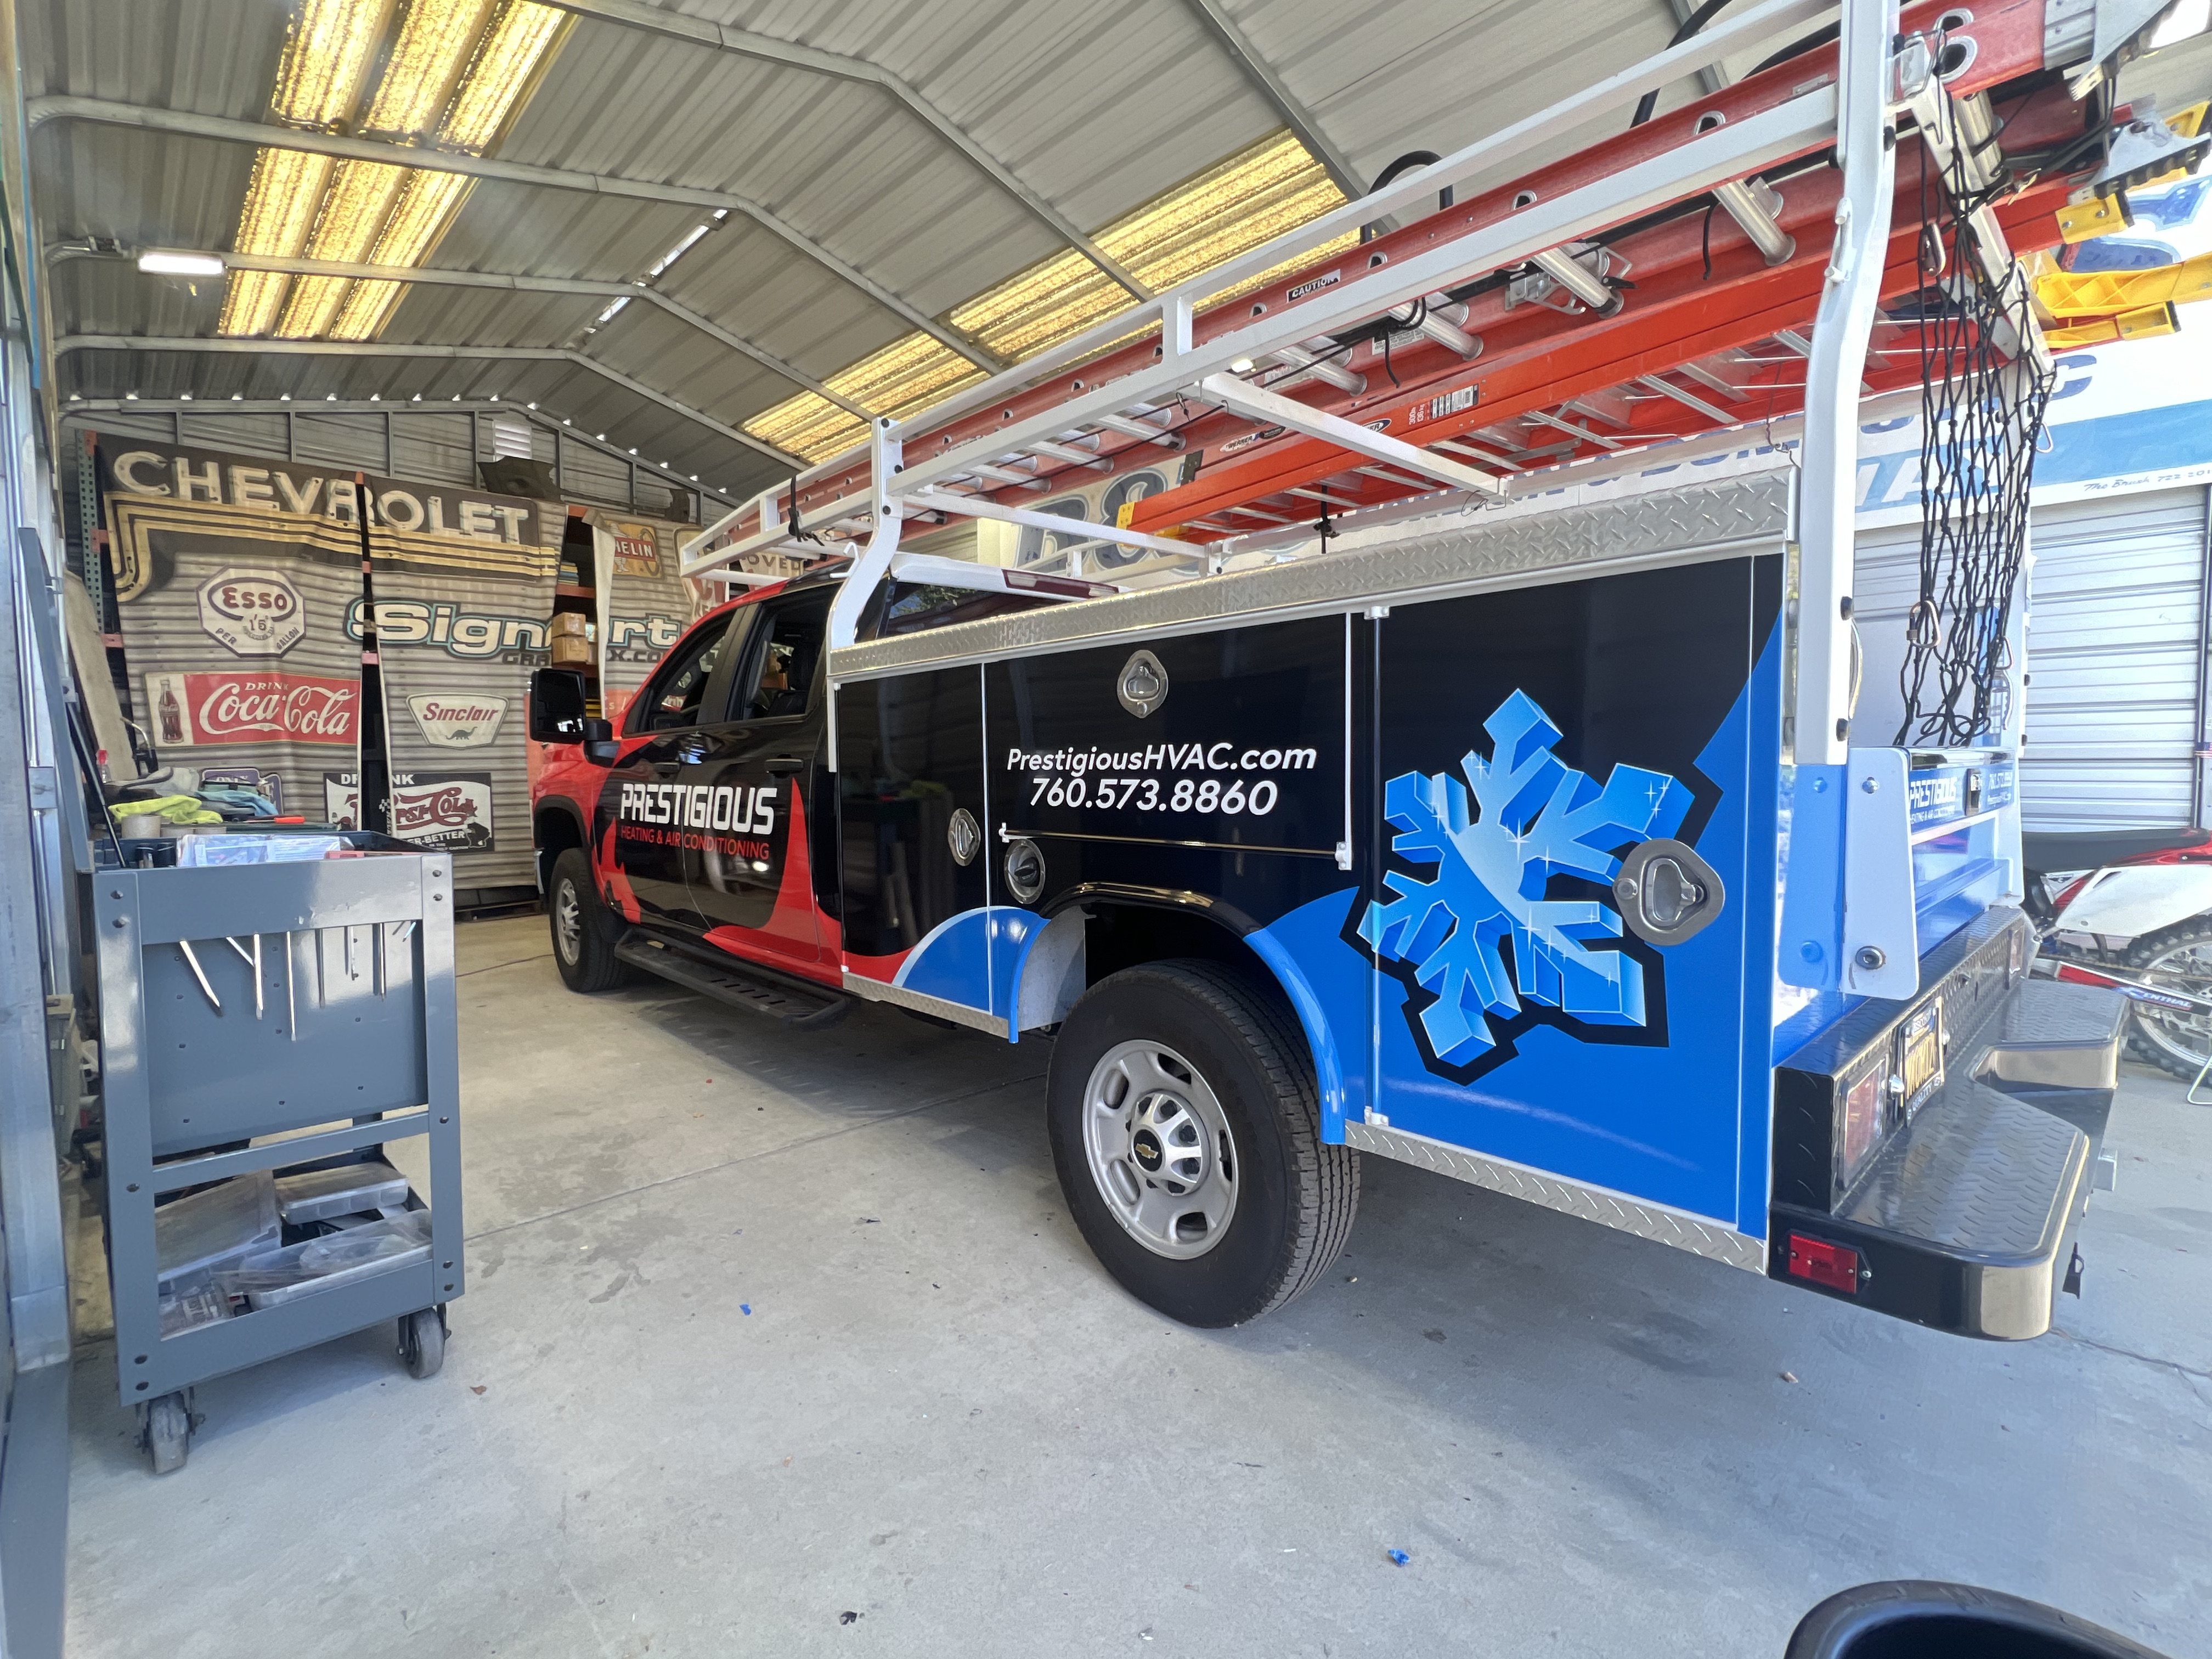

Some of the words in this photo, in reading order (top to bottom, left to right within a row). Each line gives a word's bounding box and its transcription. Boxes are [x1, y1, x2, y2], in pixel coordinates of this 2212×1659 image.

[114, 451, 528, 545] CHEVROLET
[215, 628, 238, 645] PER
[276, 627, 300, 650] GALLON
[245, 682, 289, 691] DRINK
[423, 703, 499, 722] Sinclair
[1007, 743, 1317, 777] PrestigiousHVAC.com
[620, 783, 777, 835] PRESTIGIOUS
[1030, 777, 1278, 816] 760.573.8860
[620, 825, 654, 843] HEATING
[656, 829, 664, 845] &
[664, 832, 681, 848] AIR
[684, 833, 770, 860] CONDITIONING
